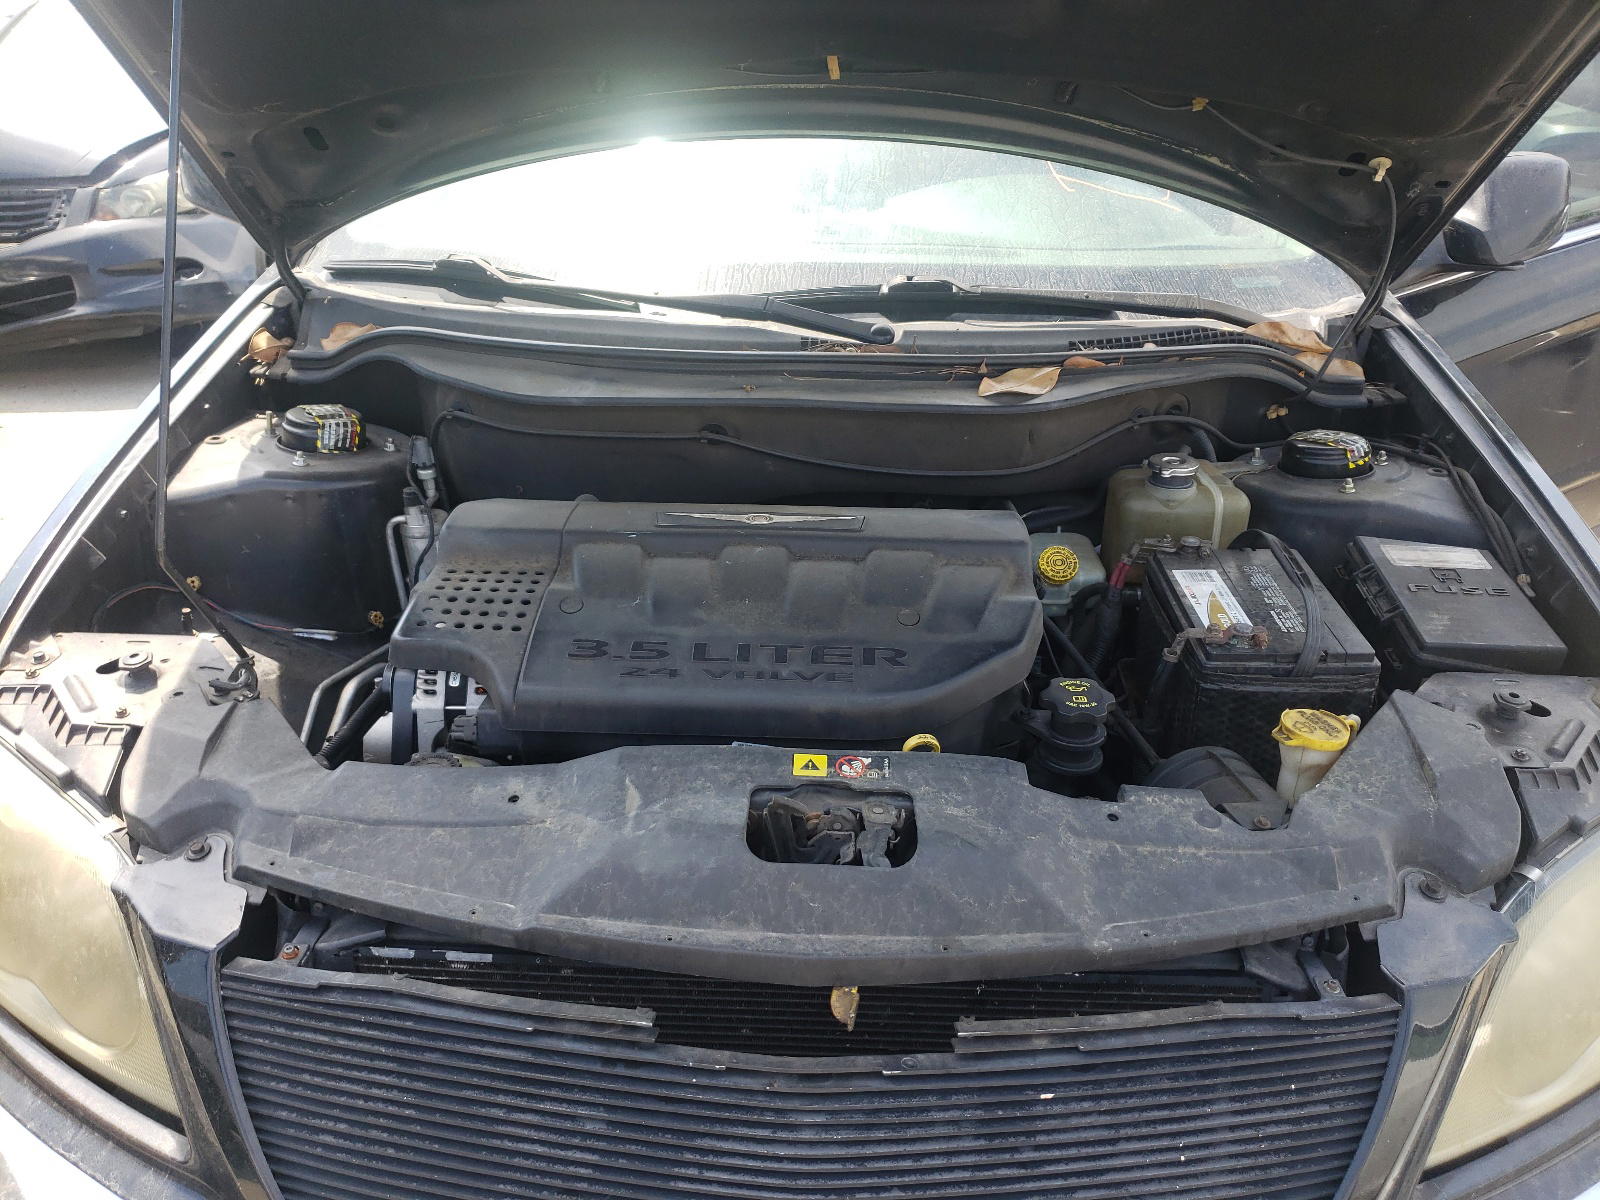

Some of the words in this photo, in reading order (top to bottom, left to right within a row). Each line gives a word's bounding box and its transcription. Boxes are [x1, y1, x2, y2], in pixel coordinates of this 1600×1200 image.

[1408, 583, 1511, 597] FUSE
[567, 637, 671, 661] 3.5
[692, 642, 911, 668] LITER
[618, 666, 680, 680] 24
